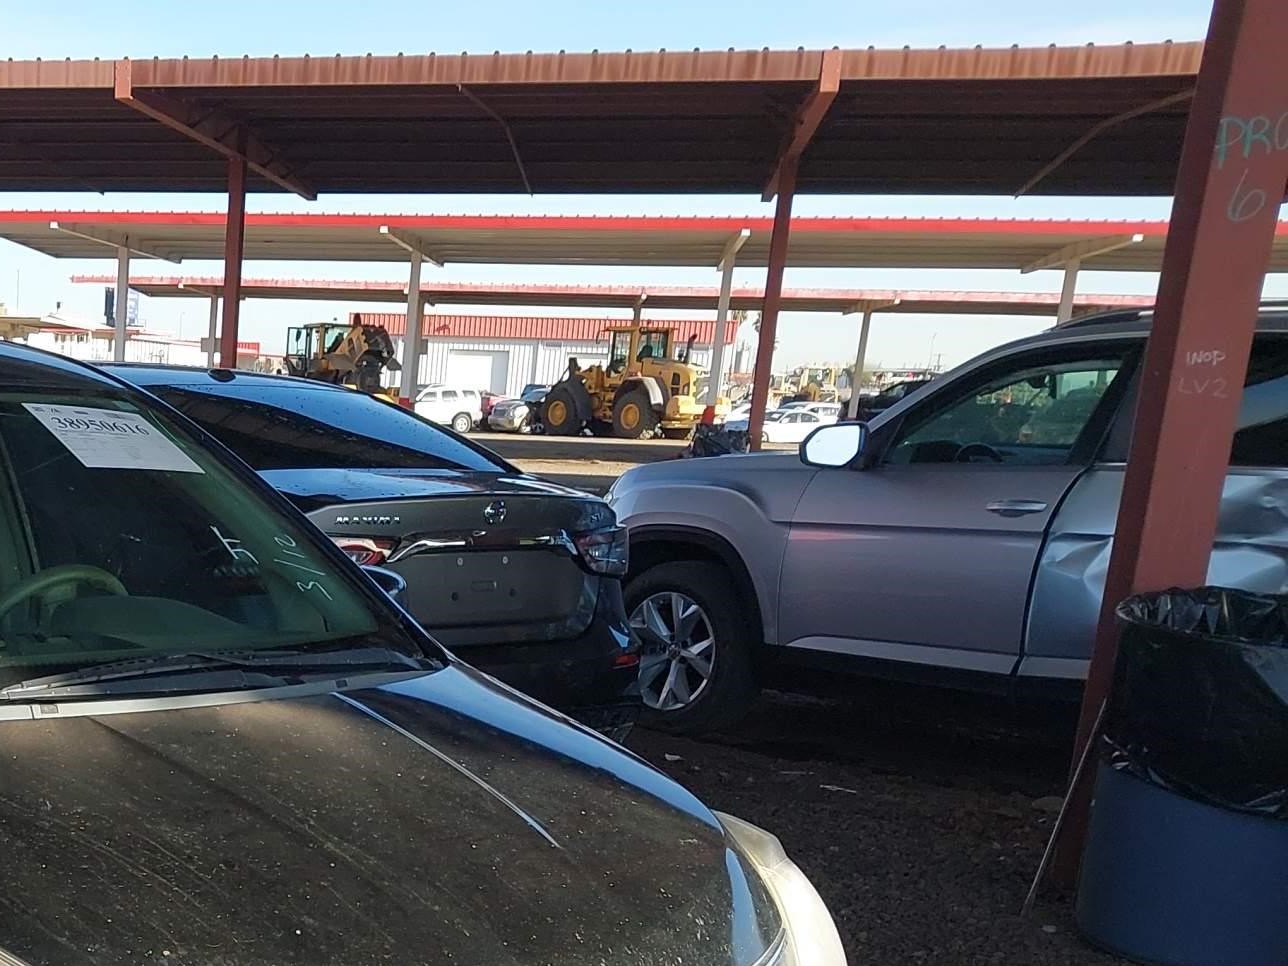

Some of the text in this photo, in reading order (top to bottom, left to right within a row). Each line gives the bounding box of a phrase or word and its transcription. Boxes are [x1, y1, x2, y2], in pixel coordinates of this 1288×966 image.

[1226, 167, 1266, 223] 6
[1186, 350, 1226, 366] INOP
[50, 416, 150, 436] 38950616
[335, 515, 401, 525] MAXIMA
